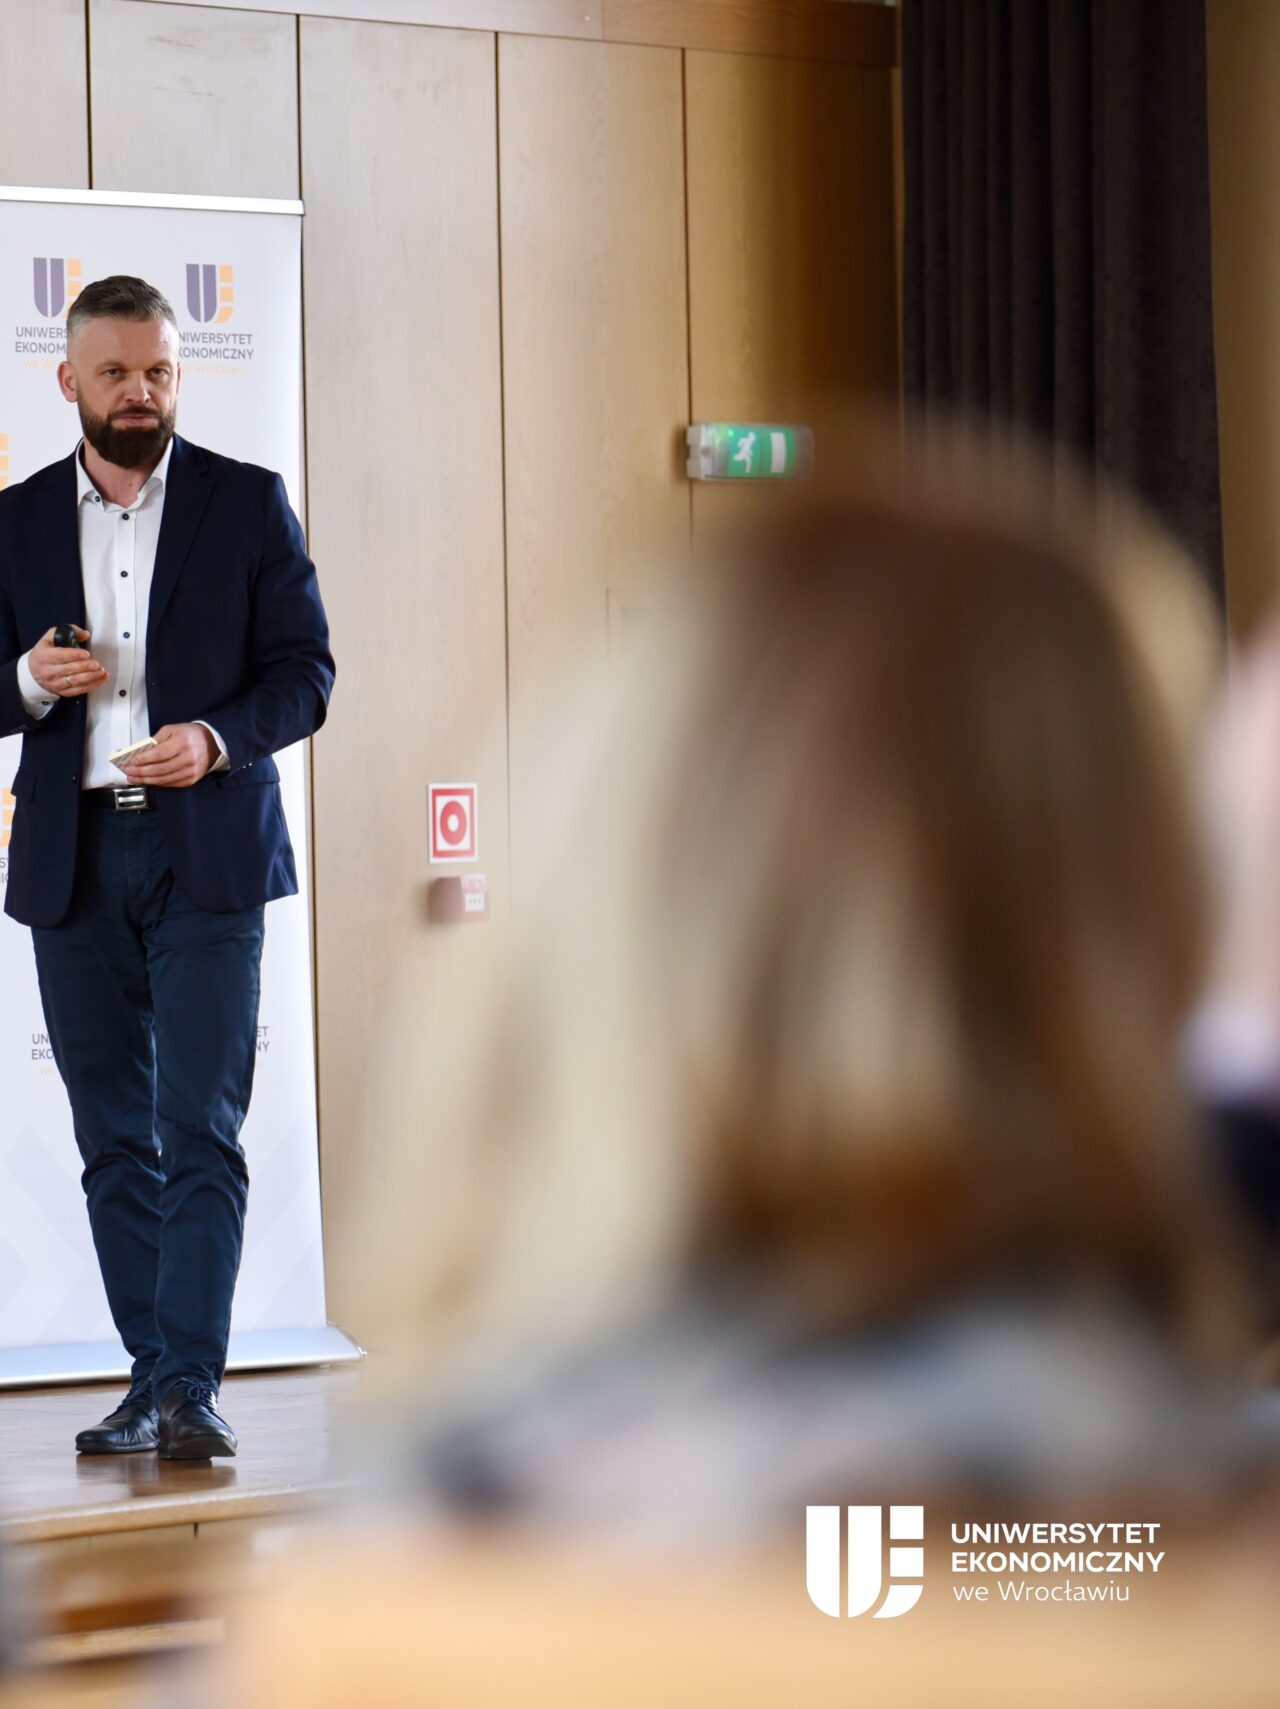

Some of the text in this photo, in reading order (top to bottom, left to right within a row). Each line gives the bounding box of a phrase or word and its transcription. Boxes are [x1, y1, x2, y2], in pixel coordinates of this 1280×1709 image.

[15, 326, 67, 340] UNIWERS
[178, 331, 253, 345] NIWERSYTET
[15, 341, 67, 354] EKONOM
